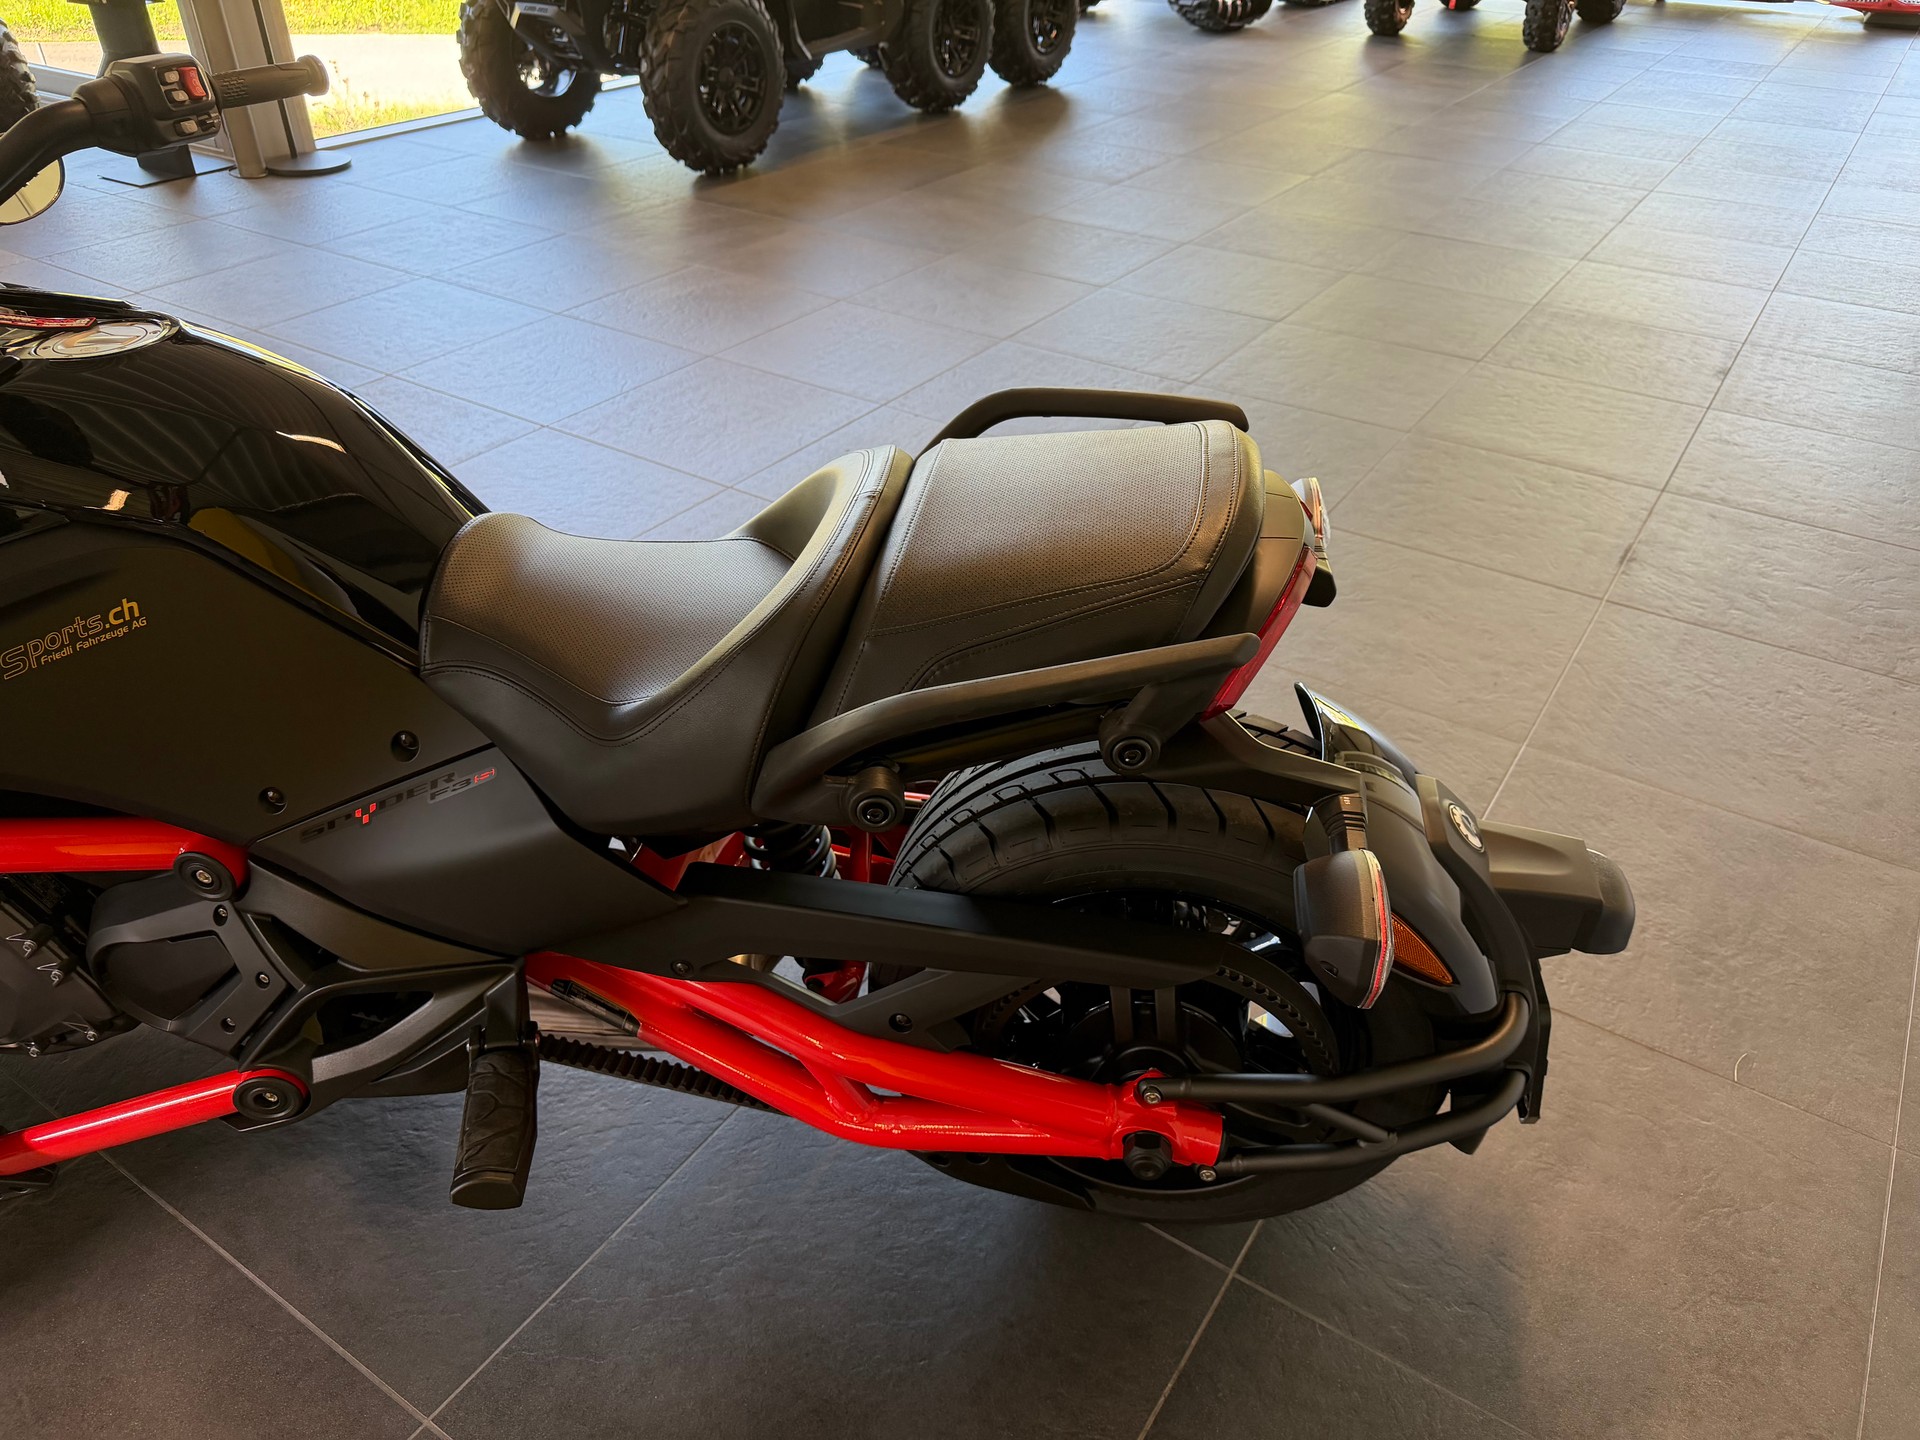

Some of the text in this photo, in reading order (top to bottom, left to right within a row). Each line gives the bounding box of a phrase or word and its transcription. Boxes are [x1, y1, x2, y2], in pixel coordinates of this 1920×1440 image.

[0, 598, 140, 680] Sports.ch
[41, 616, 147, 665] Friedli Fahrzeuge AG
